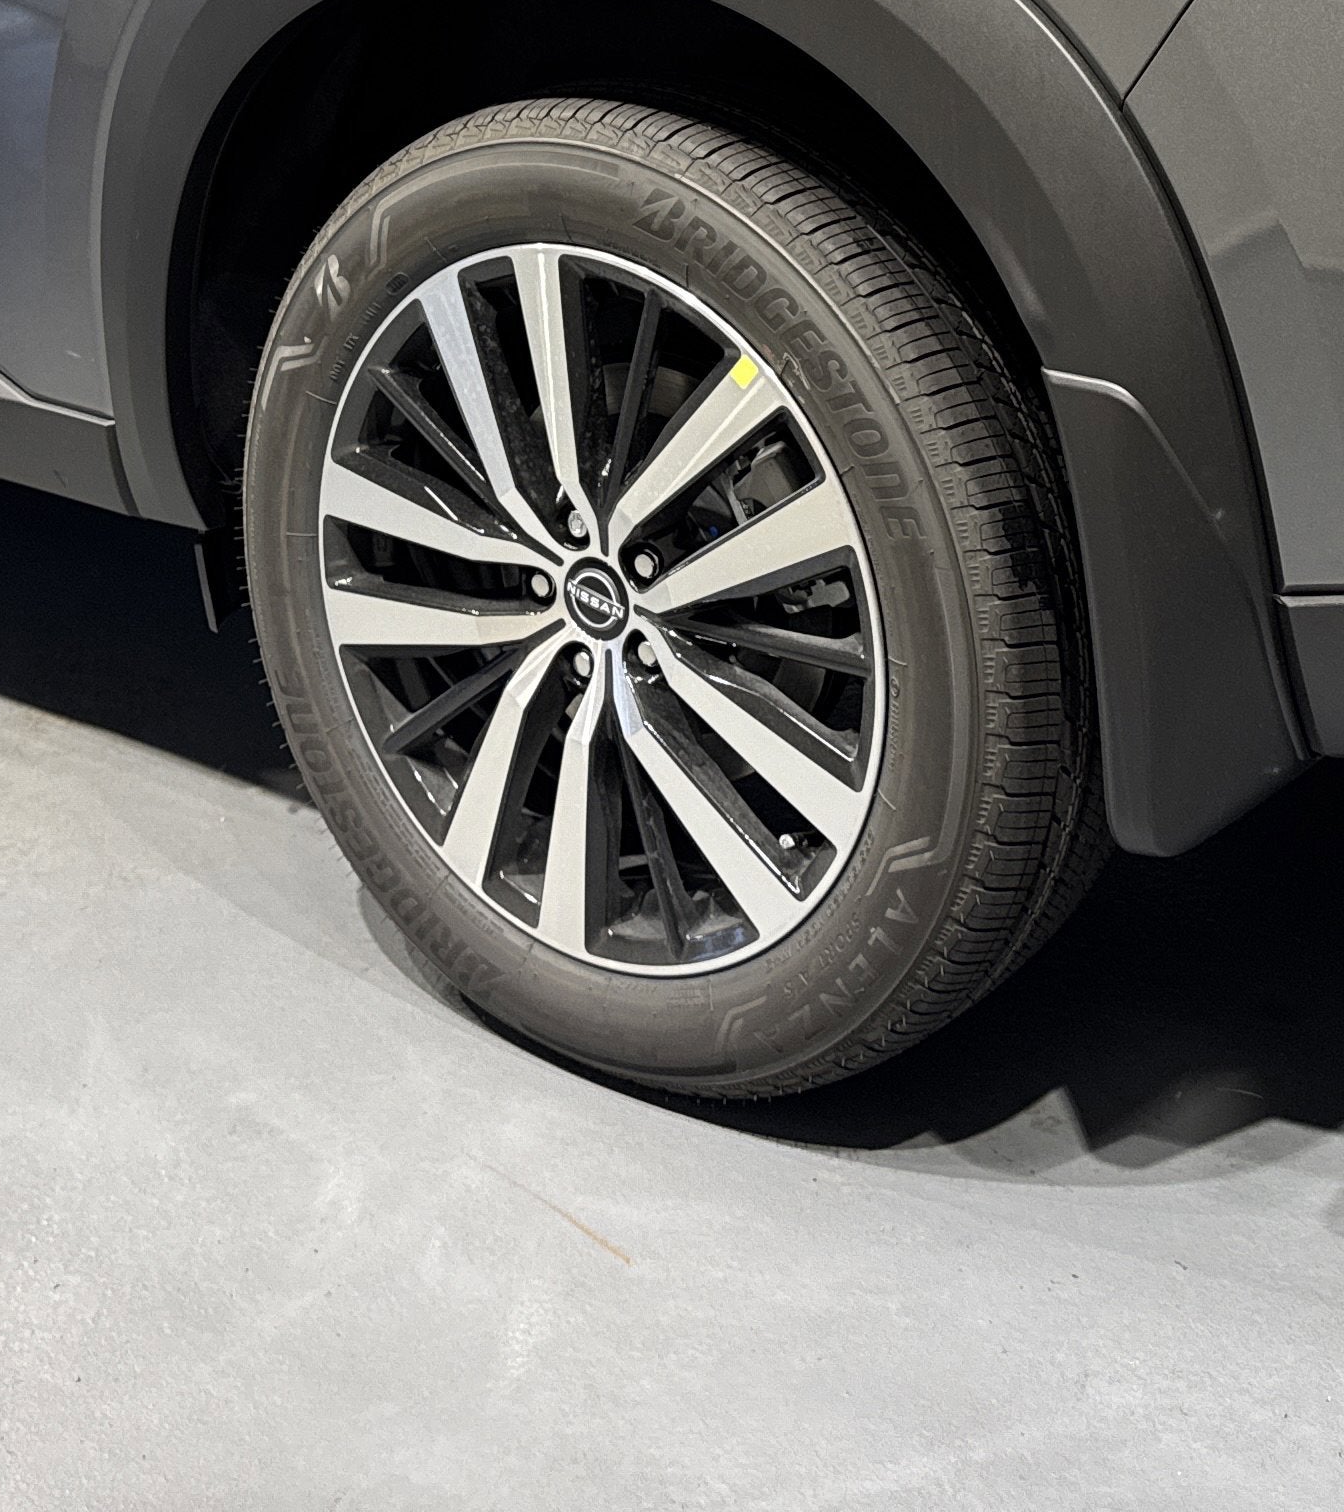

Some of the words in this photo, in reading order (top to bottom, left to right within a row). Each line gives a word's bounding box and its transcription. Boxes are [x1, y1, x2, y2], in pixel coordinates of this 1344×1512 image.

[631, 178, 929, 541] BRIDGESTONE
[567, 581, 624, 619] NISSAN
[264, 666, 506, 1006] BRIDGESTONE
[750, 886, 923, 1056] ALENZA
